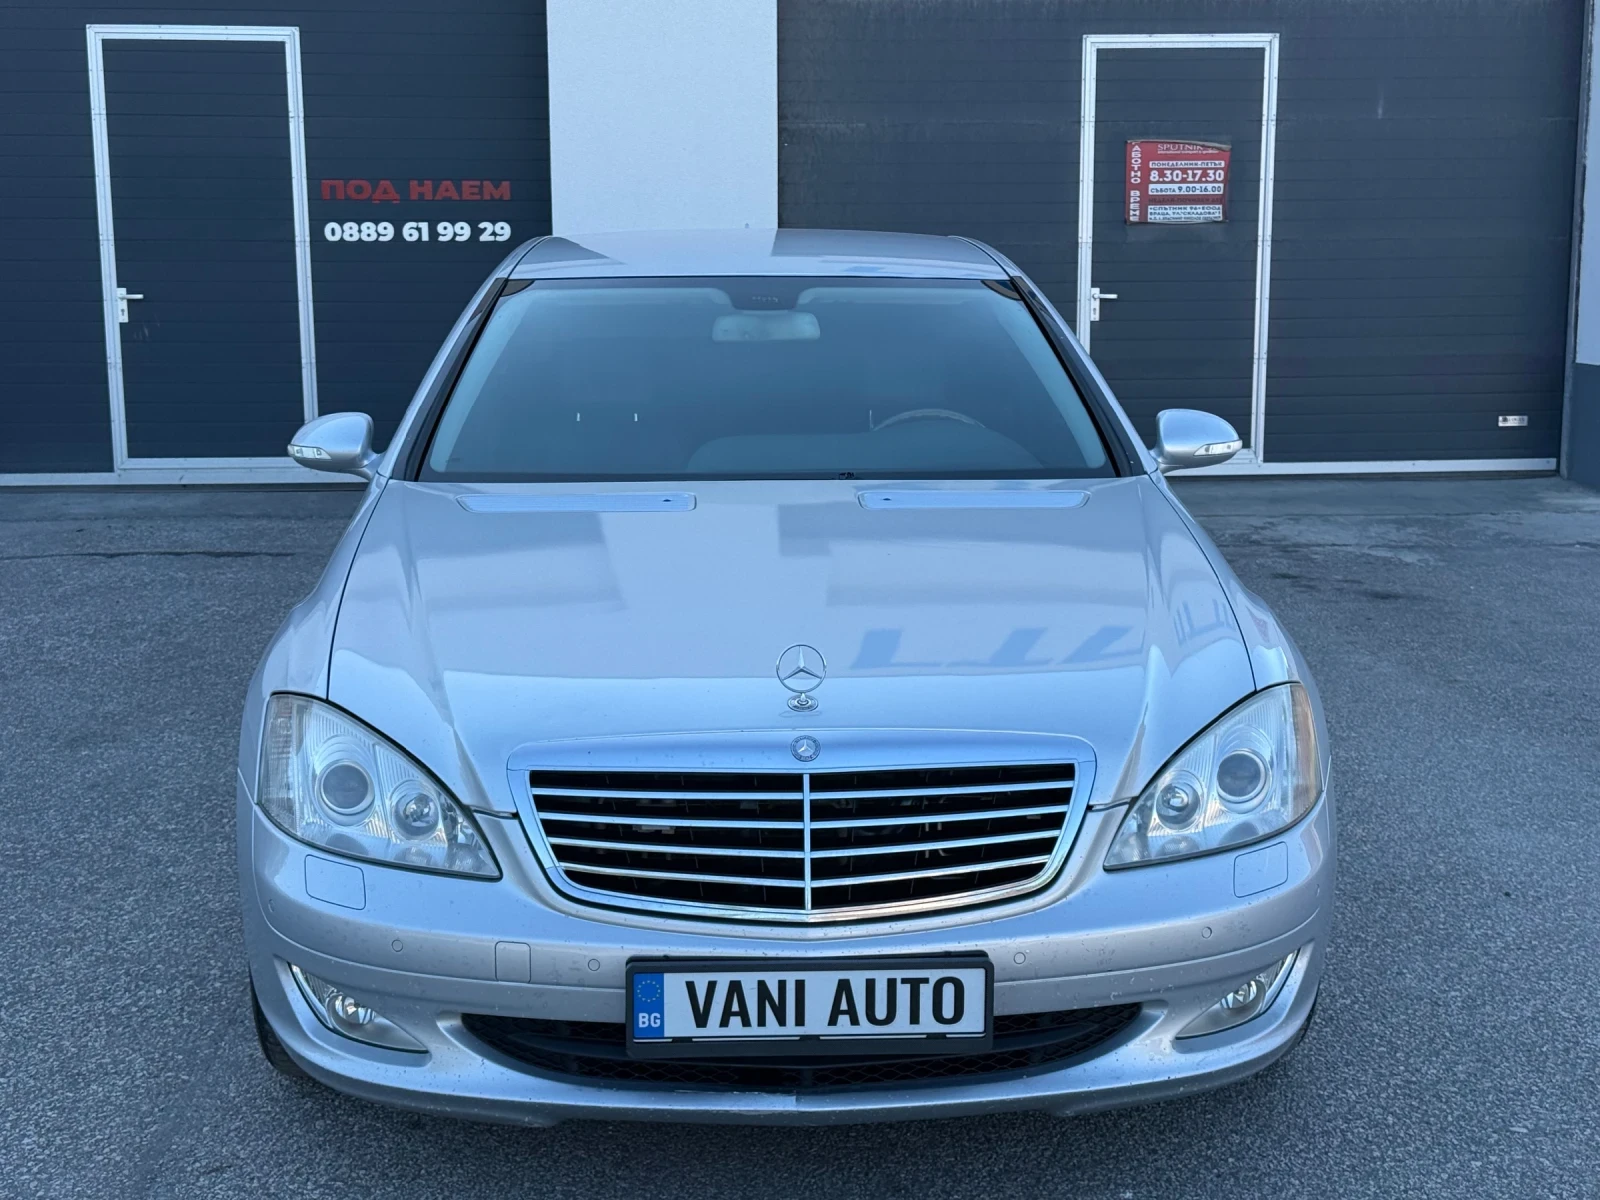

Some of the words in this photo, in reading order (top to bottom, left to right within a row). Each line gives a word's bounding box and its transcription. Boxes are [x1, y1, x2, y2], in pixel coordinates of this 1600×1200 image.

[1131, 142, 1142, 184] АБОТНО
[1149, 169, 1224, 182] 8.30-17.30
[321, 179, 400, 204] ПОД
[409, 179, 511, 201] НАЕМ
[1129, 190, 1140, 222] ВРЕМЕ
[324, 221, 395, 242] 0889
[402, 221, 429, 242] 61
[436, 221, 471, 242] 99
[477, 221, 512, 242] 29
[685, 978, 806, 1029] VANI
[827, 976, 965, 1027] AUTO
[638, 1012, 661, 1028] BG
